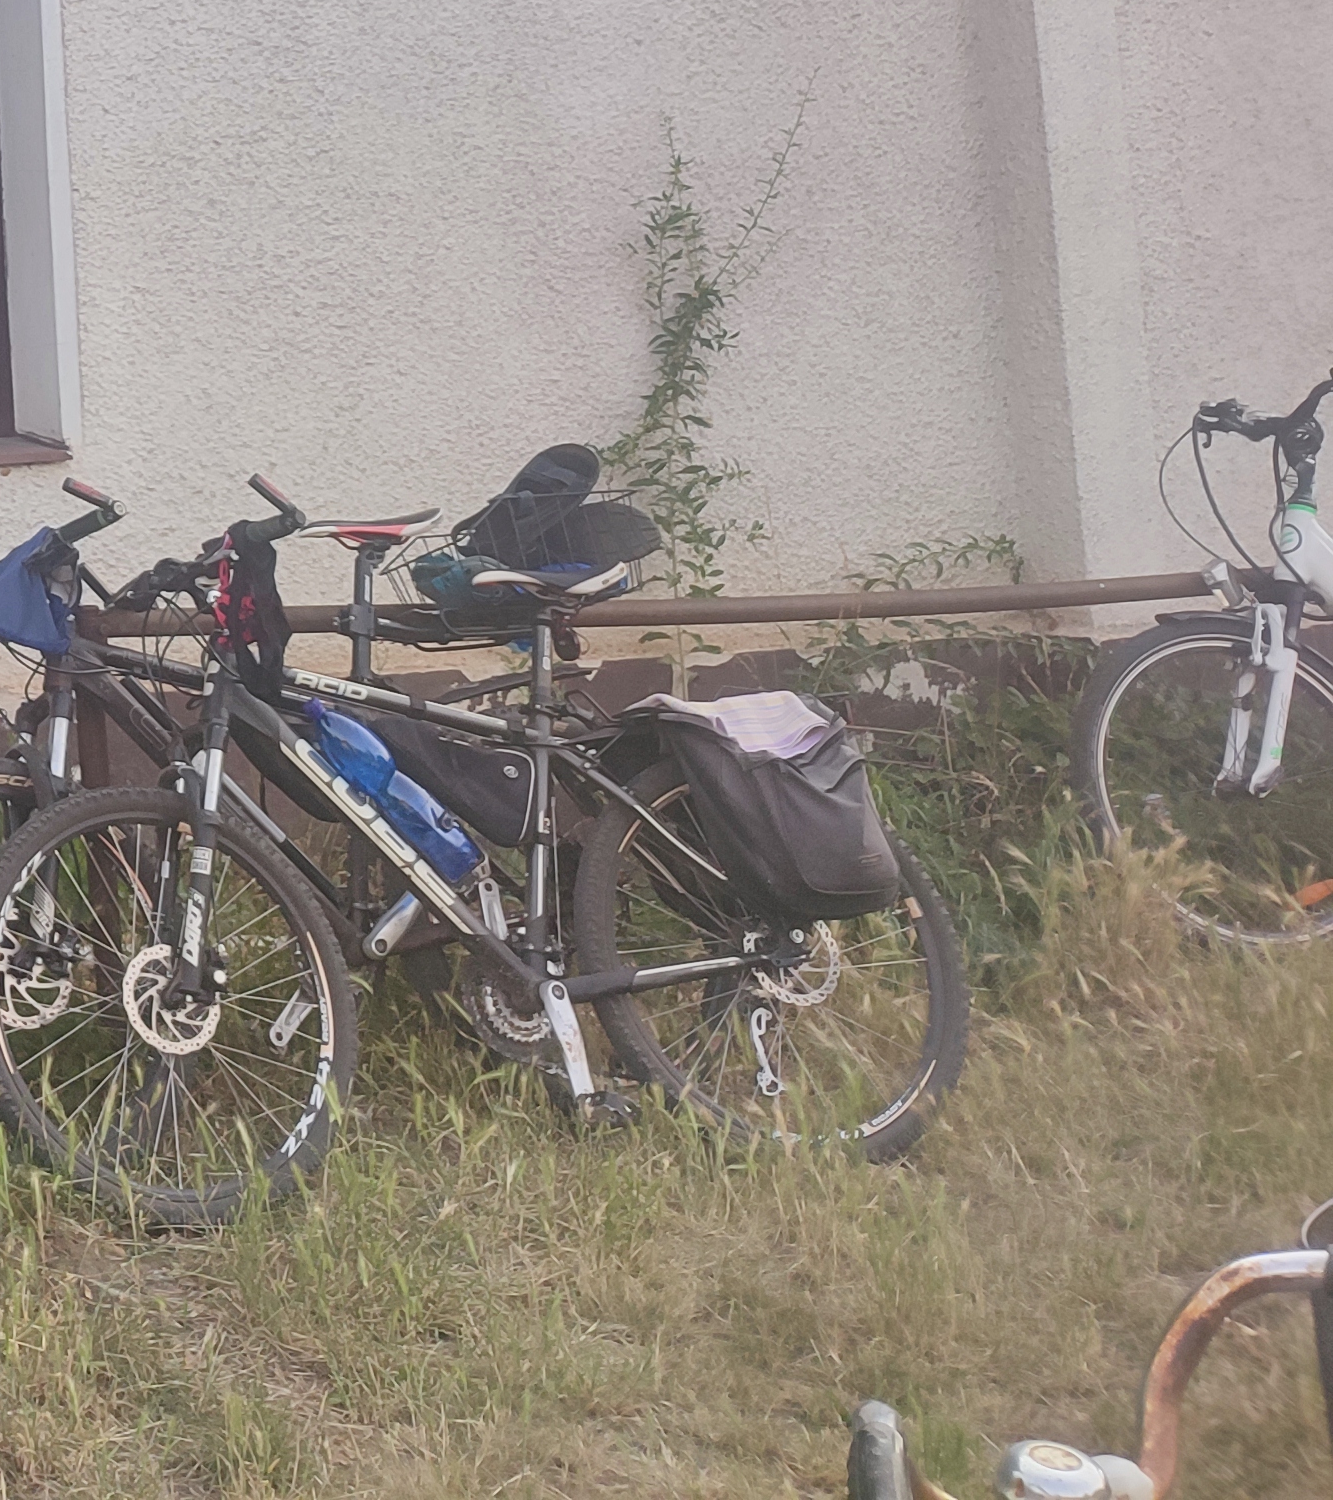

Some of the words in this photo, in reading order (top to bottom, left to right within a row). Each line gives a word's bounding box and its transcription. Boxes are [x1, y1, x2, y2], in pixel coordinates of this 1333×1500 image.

[294, 673, 369, 701] ACID
[295, 738, 458, 907] CUBE
[181, 898, 203, 968] DART
